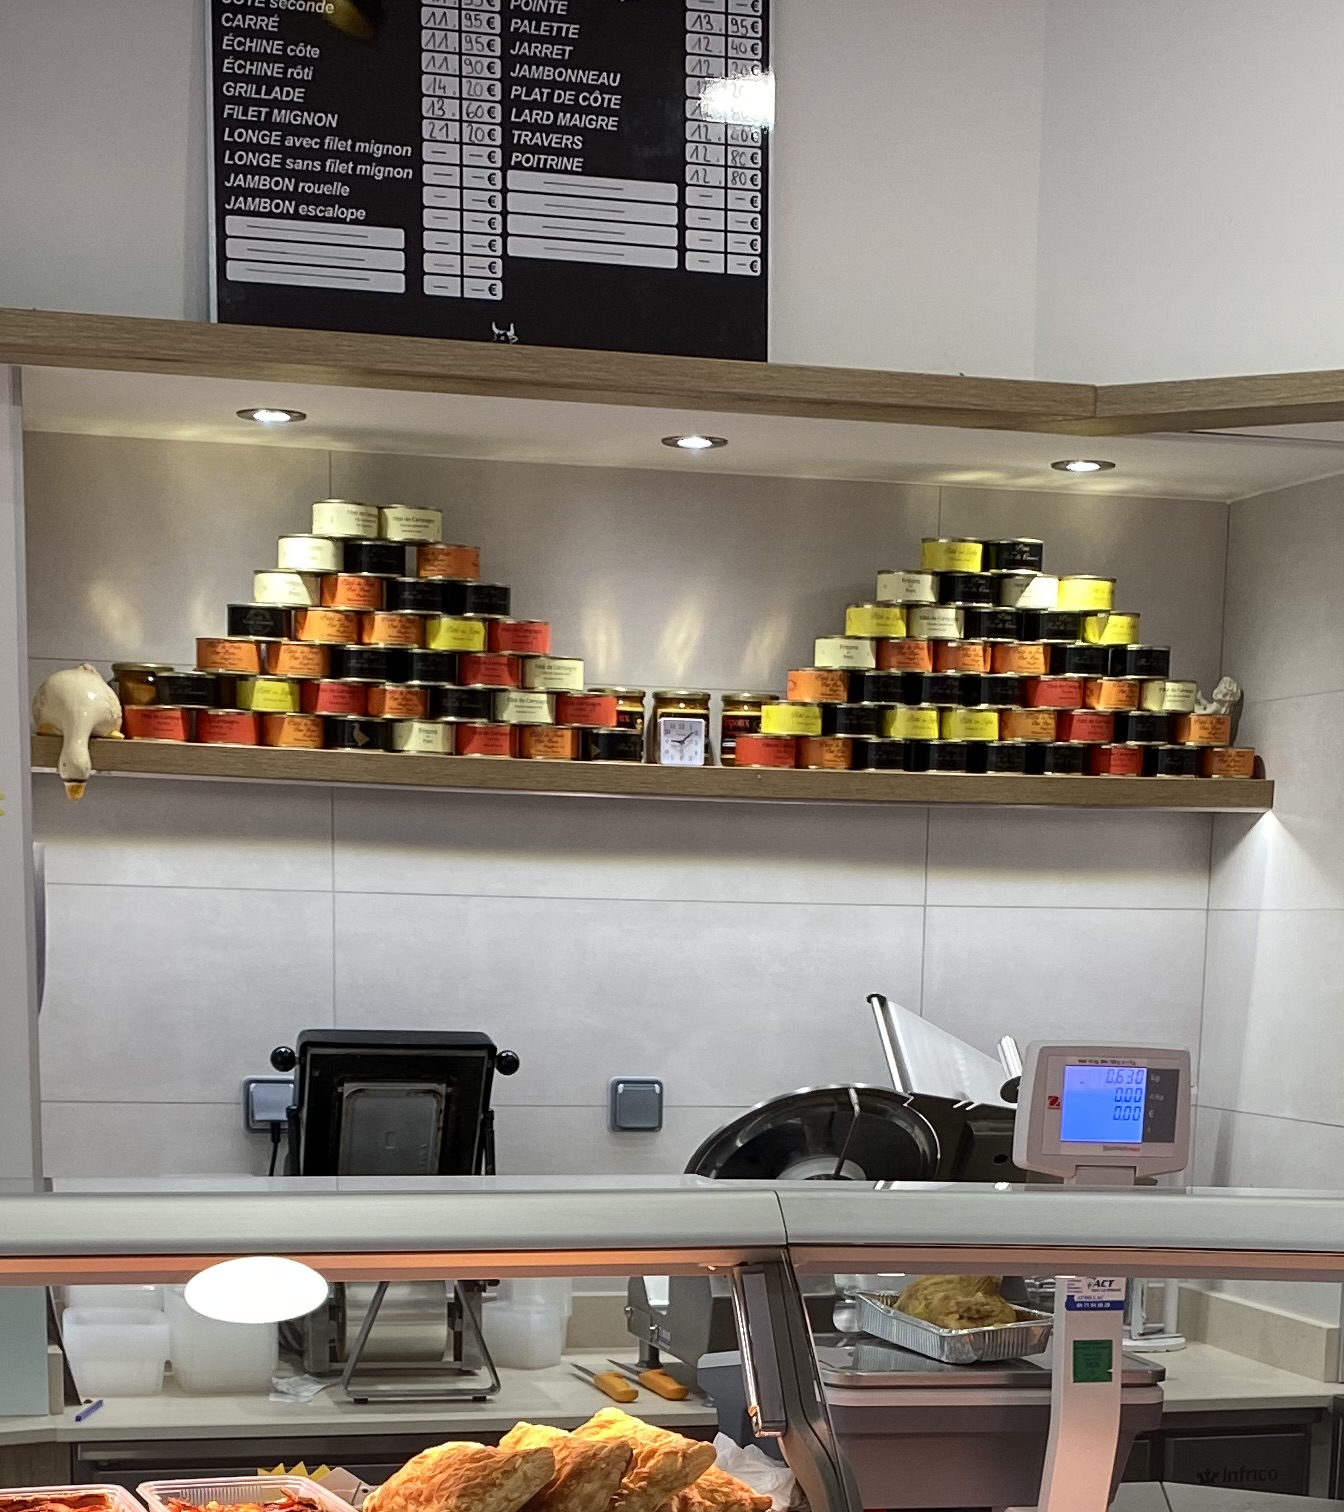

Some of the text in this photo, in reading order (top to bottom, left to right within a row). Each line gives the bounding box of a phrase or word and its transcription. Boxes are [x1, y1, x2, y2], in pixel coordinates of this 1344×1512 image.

[510, 0, 568, 15] POINTE
[221, 13, 280, 32] CARRÉ
[510, 19, 580, 39] PALETTE
[222, 36, 320, 59] ÉCHINE côte
[510, 41, 573, 60] JARRET
[222, 58, 313, 80] ÉCHINE rôti
[510, 63, 621, 87] JAMBONNEAU
[222, 81, 306, 102] GRILLADE
[510, 85, 622, 109] PLAT DE CÔTE
[223, 104, 339, 128] FILET MIGNON
[511, 107, 619, 131] LARD MAIGRE
[223, 127, 412, 158] LONGE avec filet mignon
[511, 130, 583, 150] TRAVERS
[224, 150, 413, 180] LONGE sans filet mignon
[511, 152, 584, 172] POITRINE
[225, 173, 350, 196] JAMBON rouelle
[225, 196, 366, 221] JAMBON escalope
[1114, 1087, 1143, 1103] 0.00
[1113, 1106, 1142, 1121] 0.00
